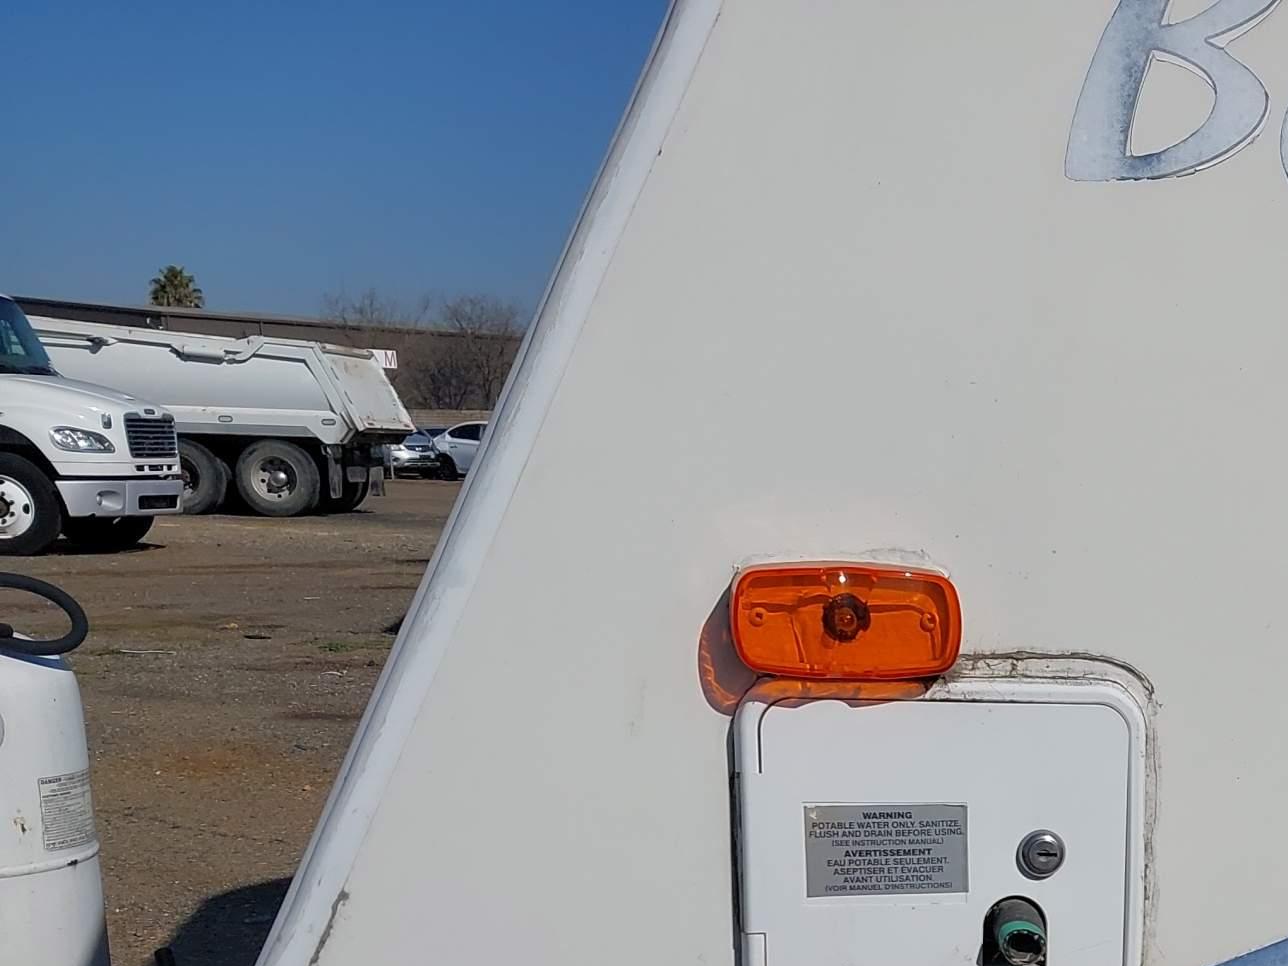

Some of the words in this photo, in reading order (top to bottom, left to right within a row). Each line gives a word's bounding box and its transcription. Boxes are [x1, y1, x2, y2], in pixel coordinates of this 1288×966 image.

[862, 811, 913, 820] WARNING
[811, 821, 856, 830] POTABLE
[857, 821, 890, 829] WATER
[809, 830, 840, 839] FLUSH
[841, 829, 862, 838] AND
[863, 829, 893, 838] DRAIN
[895, 828, 934, 837] BEFORE
[852, 838, 907, 846] INSTRUCTION
[908, 837, 945, 846] MANUAL)
[844, 848, 933, 858] AVERTISSEMENT
[827, 859, 847, 867] EAU
[848, 858, 891, 867] POTABLE
[833, 867, 886, 876] ASEPTISER
[887, 866, 900, 875] ET
[843, 875, 873, 884] AVANT
[824, 884, 848, 893] (VOIR
[849, 883, 883, 892] MANUEL
